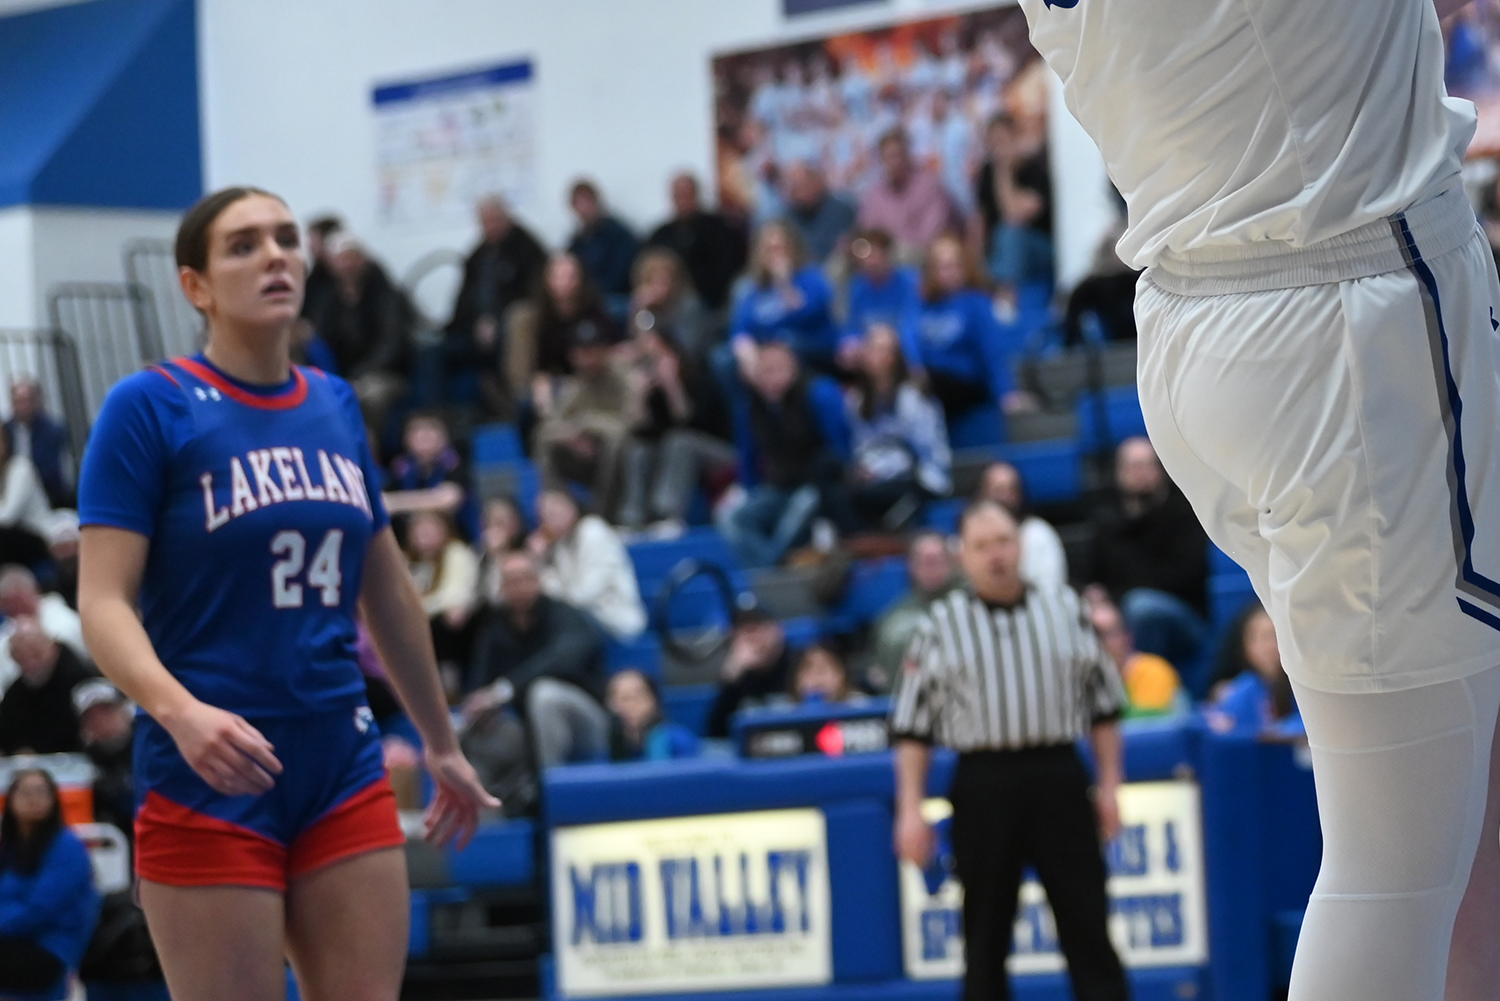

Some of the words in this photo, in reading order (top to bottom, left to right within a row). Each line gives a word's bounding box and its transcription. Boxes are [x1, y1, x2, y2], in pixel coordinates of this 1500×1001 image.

[200, 446, 374, 533] LAKELAN
[269, 527, 345, 609] 24
[570, 860, 642, 945] MID
[659, 850, 810, 941] VALLEY
